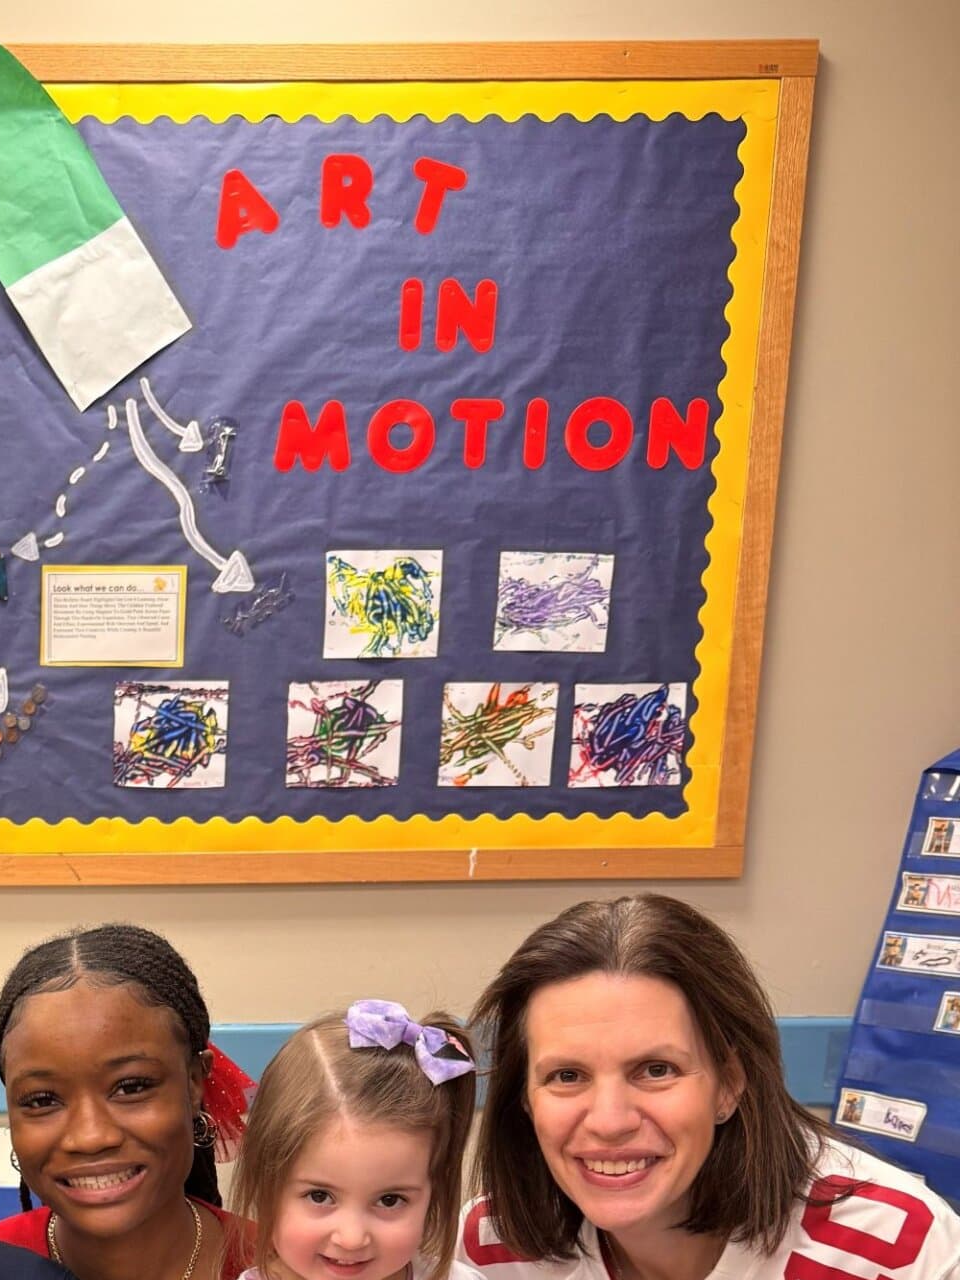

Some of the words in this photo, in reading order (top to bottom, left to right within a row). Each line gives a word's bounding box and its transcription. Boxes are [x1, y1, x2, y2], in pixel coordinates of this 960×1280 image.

[215, 153, 468, 250] ART
[399, 278, 498, 353] IN
[274, 396, 710, 473] MOTION
[53, 584, 71, 593] Look
[74, 584, 93, 593] what
